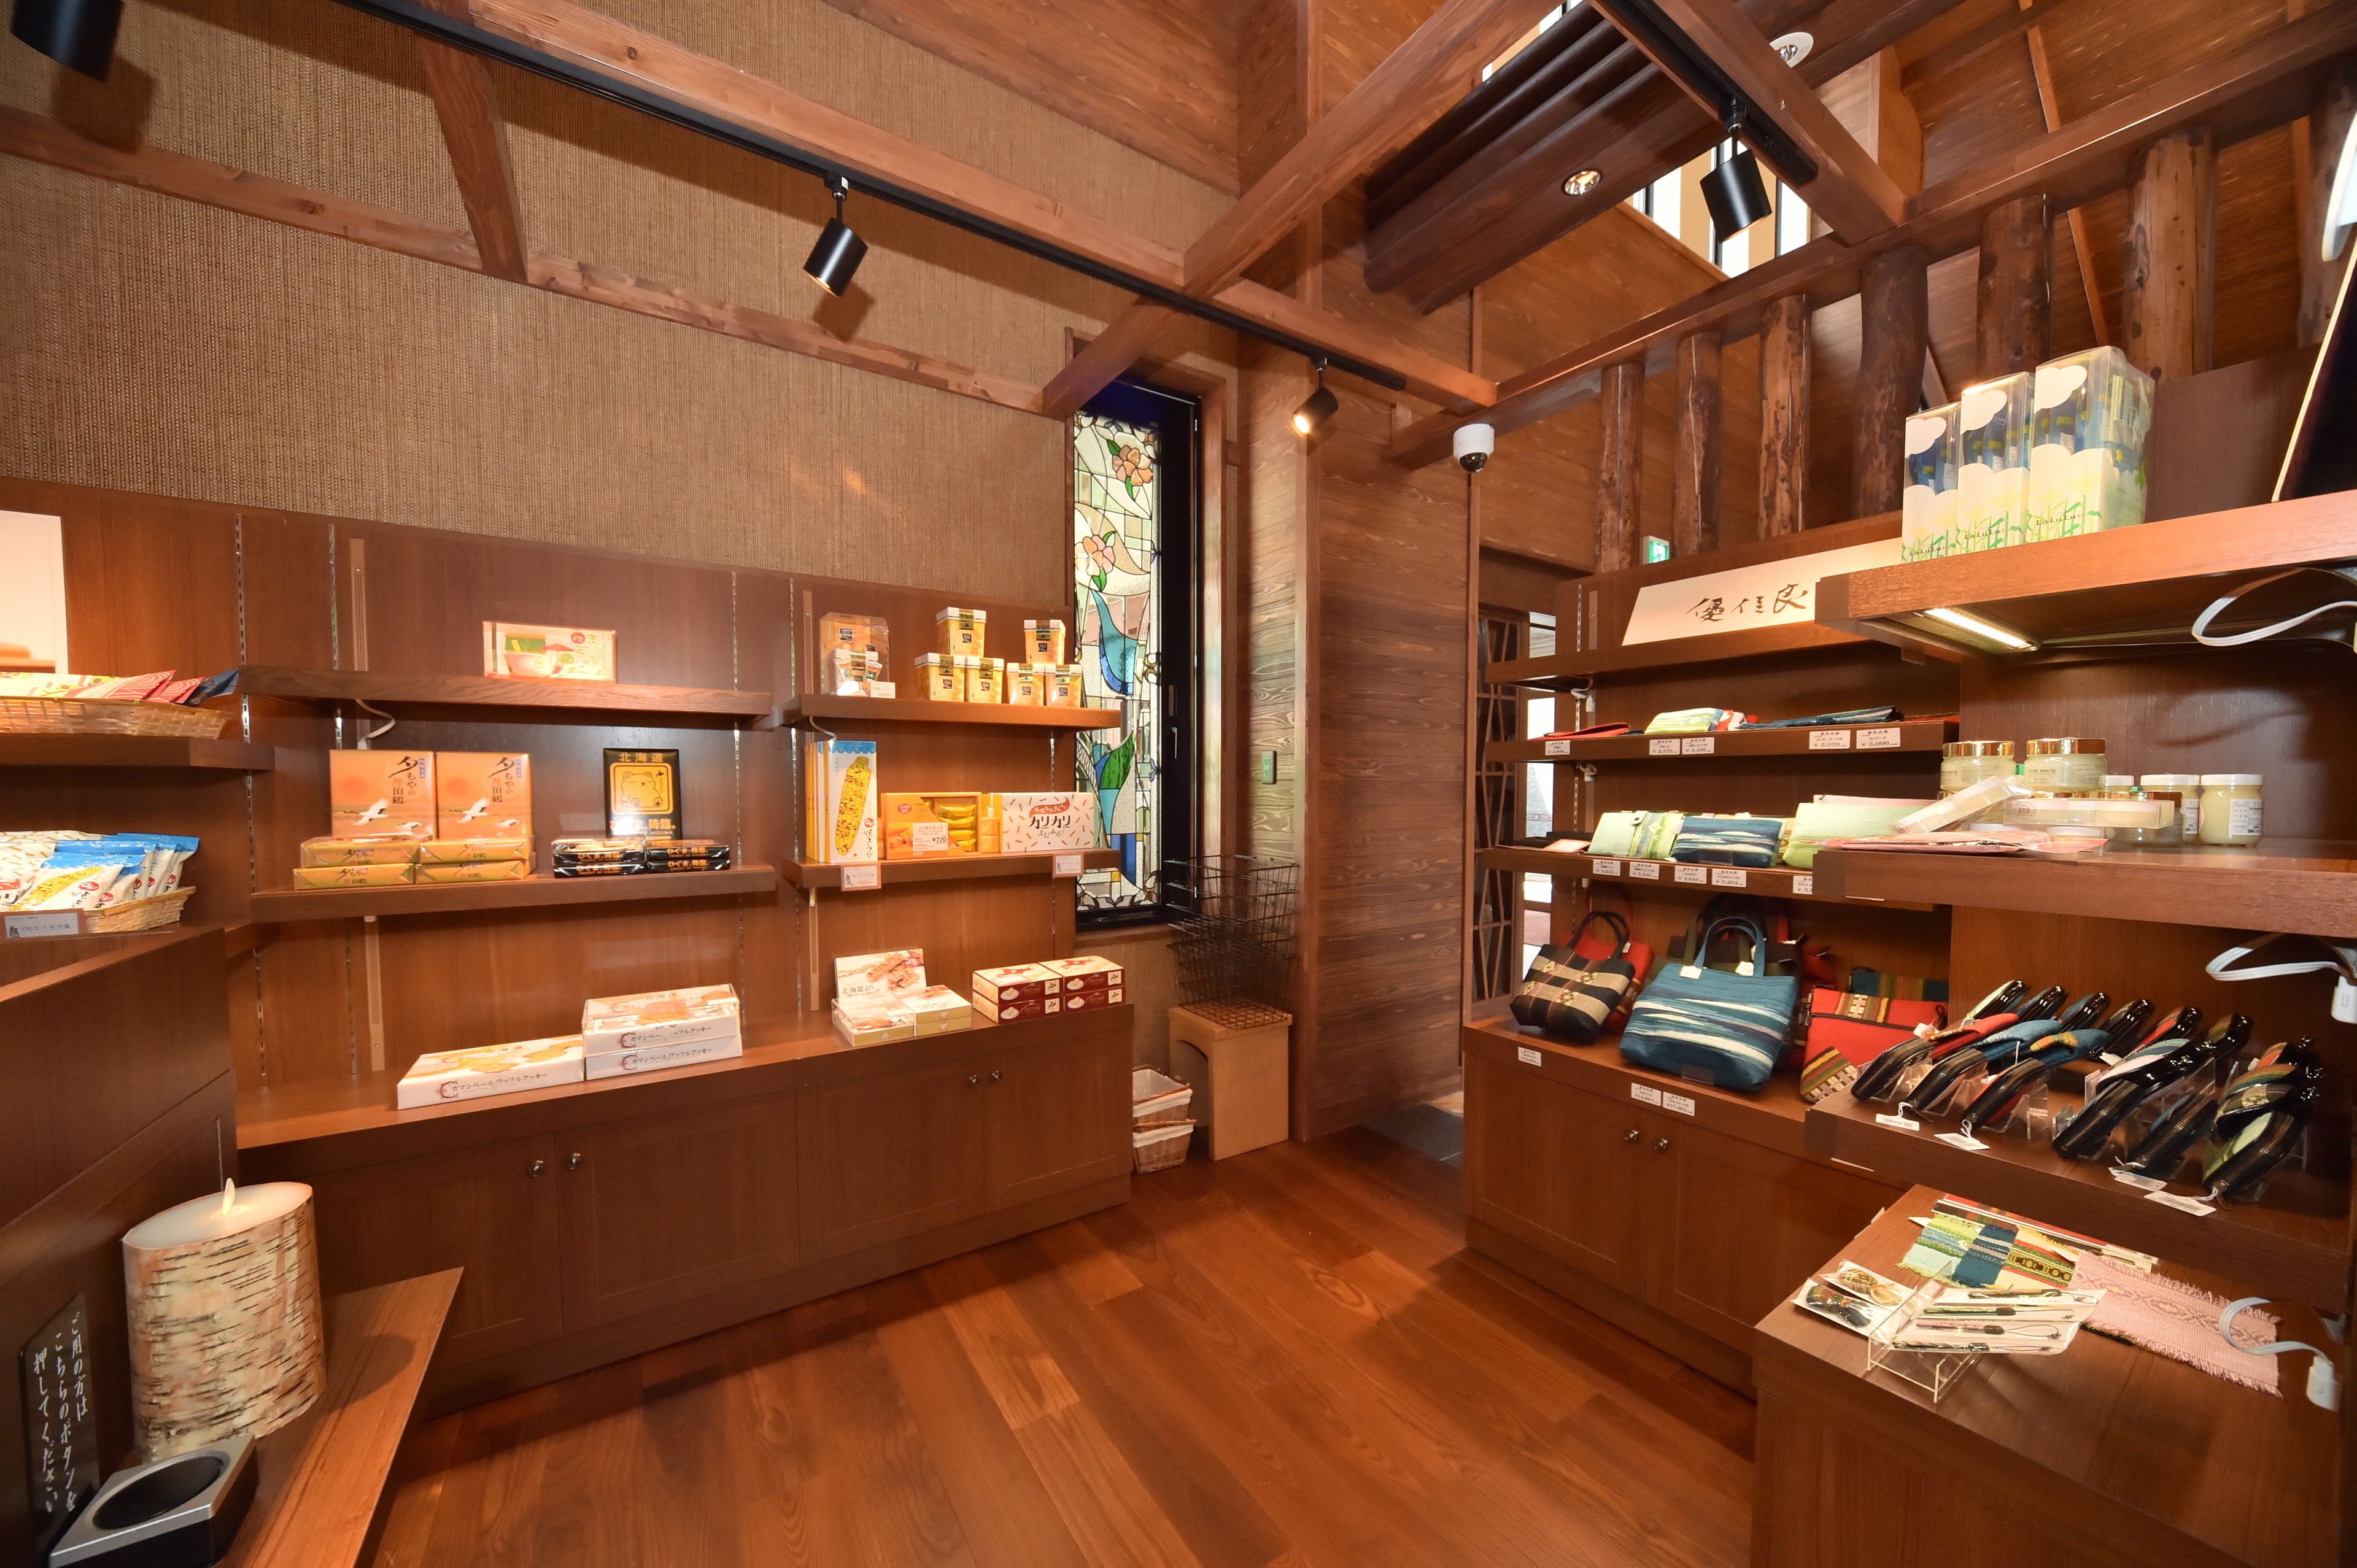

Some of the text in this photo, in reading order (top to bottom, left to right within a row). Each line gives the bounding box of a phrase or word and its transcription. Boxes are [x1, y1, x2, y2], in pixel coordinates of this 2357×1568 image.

[618, 752, 664, 763] 北海道
[1029, 815, 1070, 829] カリカリ
[631, 1027, 711, 1041] カマンベーッフルクッキー
[452, 1073, 548, 1091] カマンベールワッフルクッキー
[72, 1311, 88, 1422] ご用の方は
[34, 1347, 58, 1513] 押してください
[55, 1332, 77, 1512] こちらのボタンを
